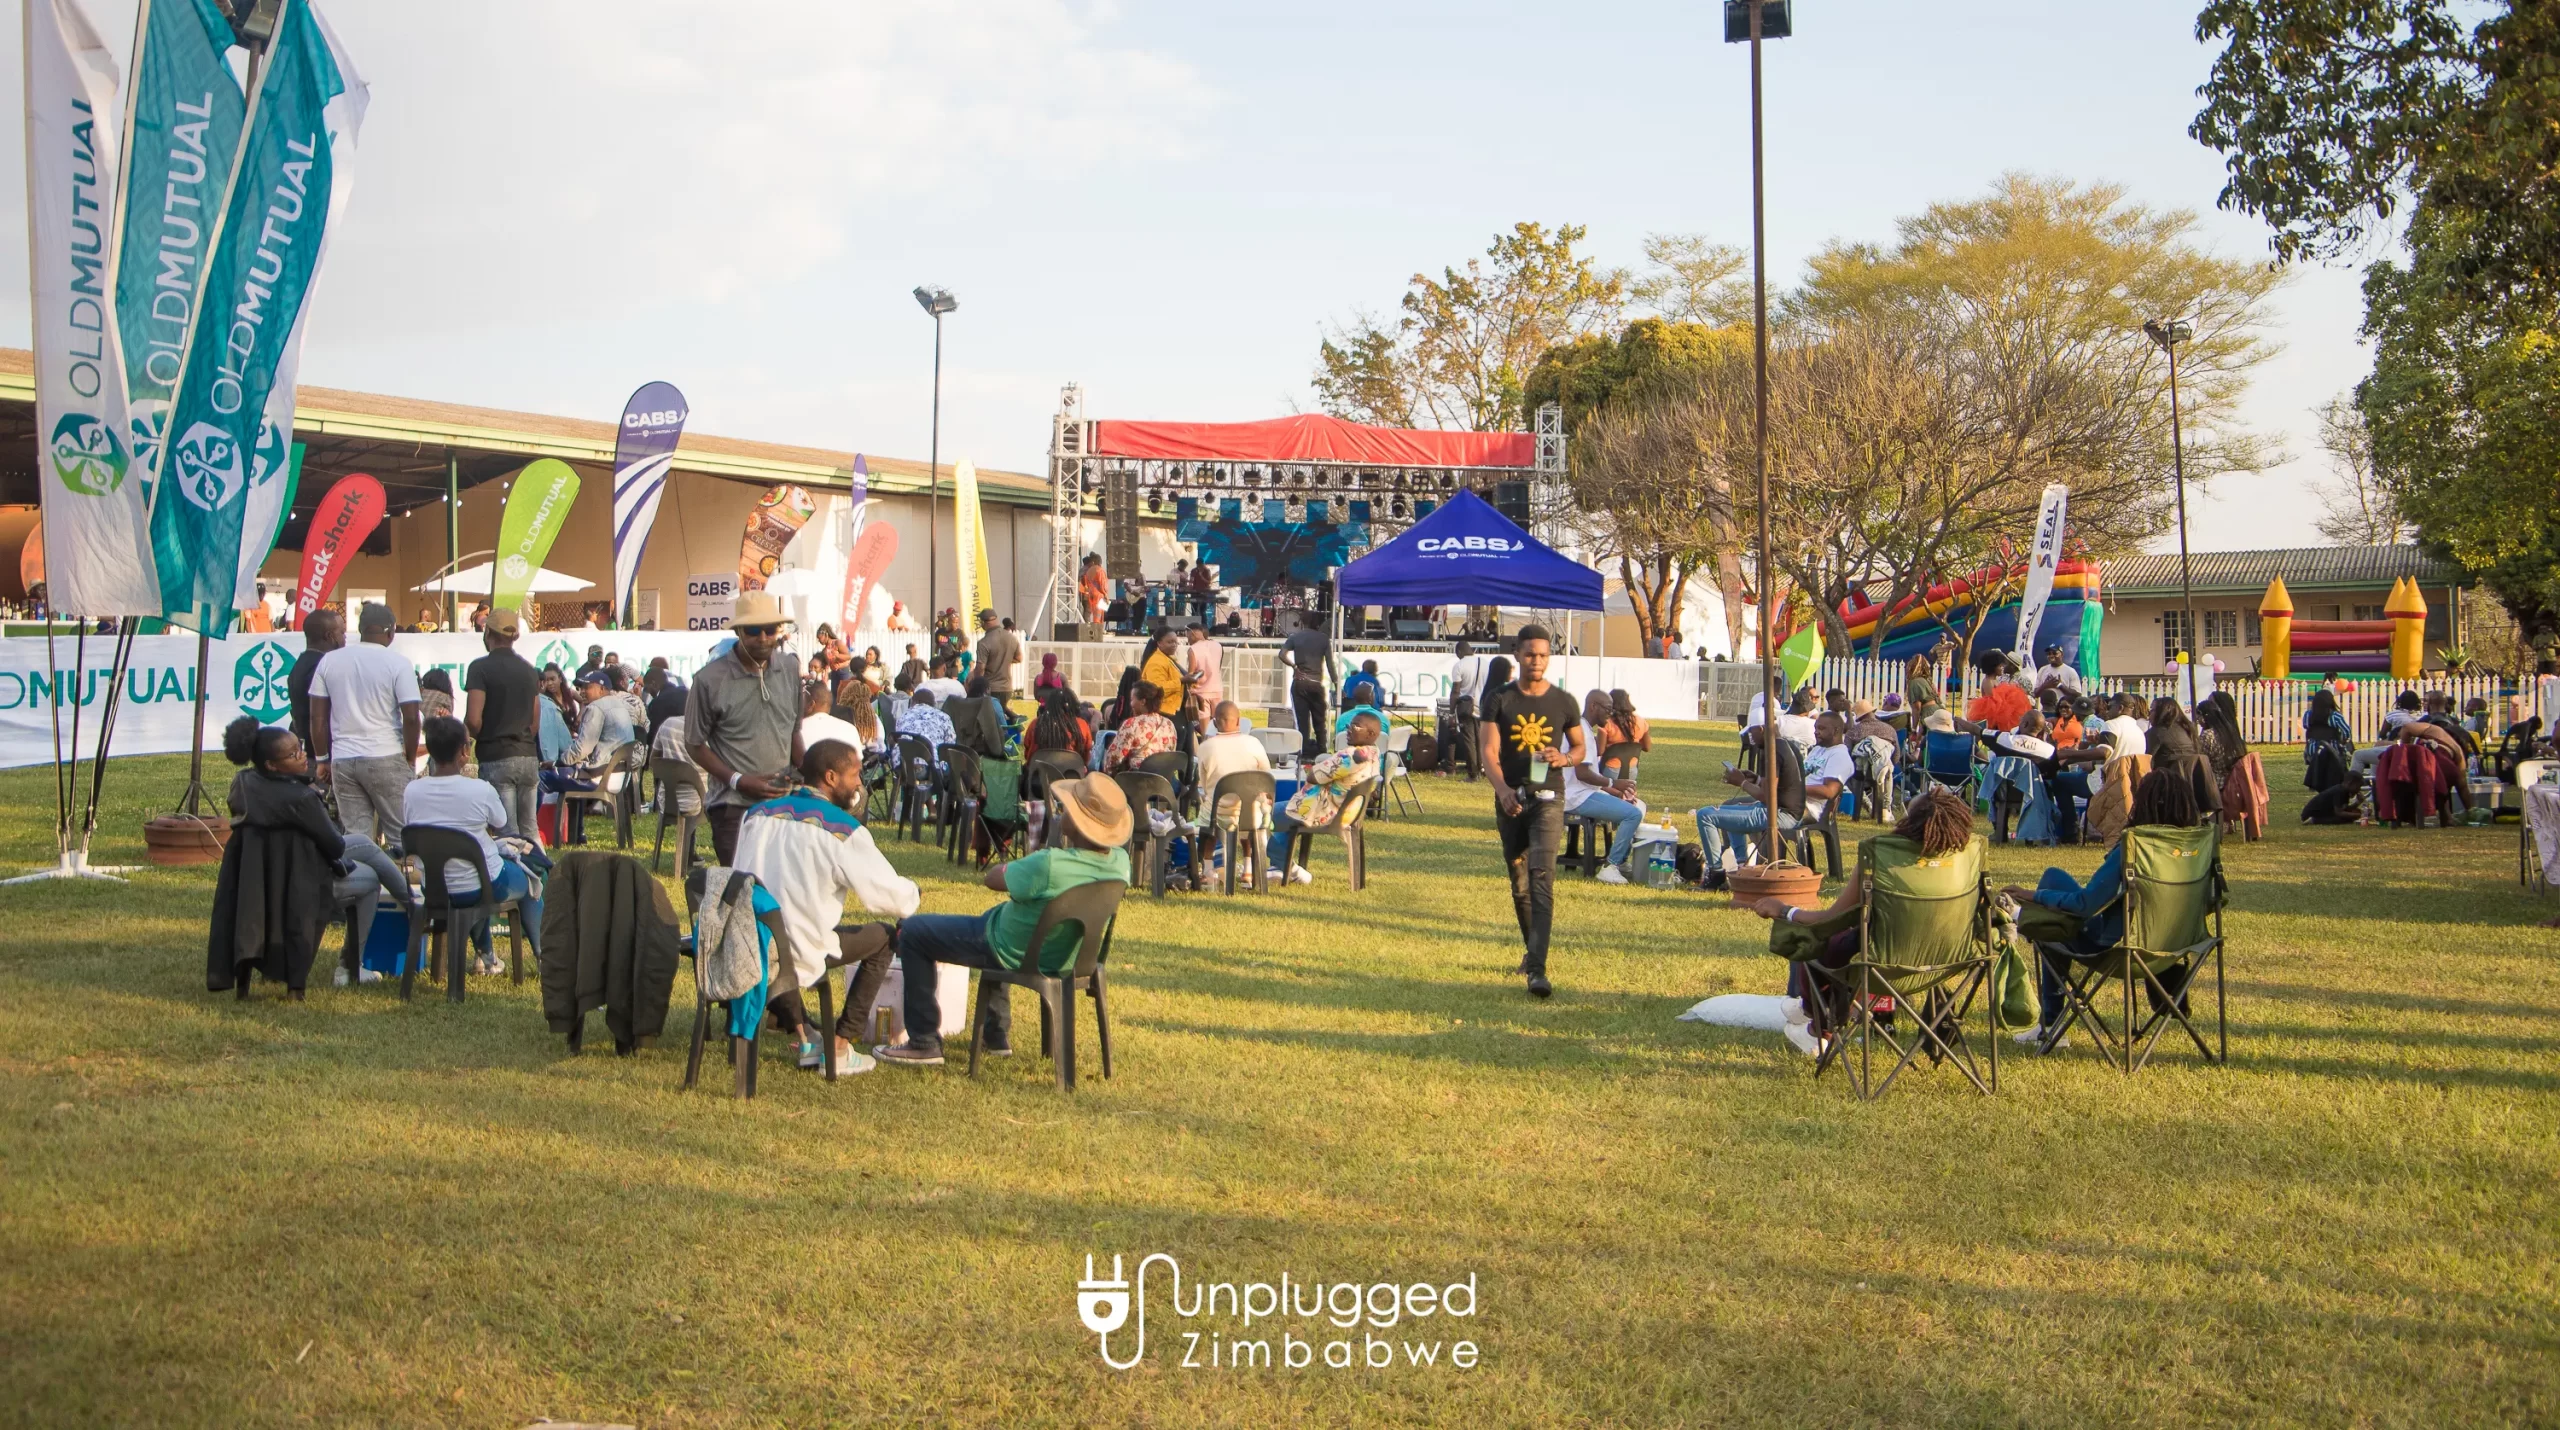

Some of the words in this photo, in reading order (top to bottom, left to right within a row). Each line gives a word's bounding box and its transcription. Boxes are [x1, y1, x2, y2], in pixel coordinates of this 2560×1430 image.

[145, 91, 214, 386] OLDMUTUAL
[211, 131, 317, 415] OLDMUTUAL
[624, 409, 679, 428] CABS
[299, 488, 366, 614] Blackshark
[520, 476, 568, 553] OLDMUTUAL
[1417, 536, 1510, 552] CABS
[2040, 504, 2056, 550] SEAL
[688, 581, 731, 597] CABS
[844, 531, 886, 624] Blackshark
